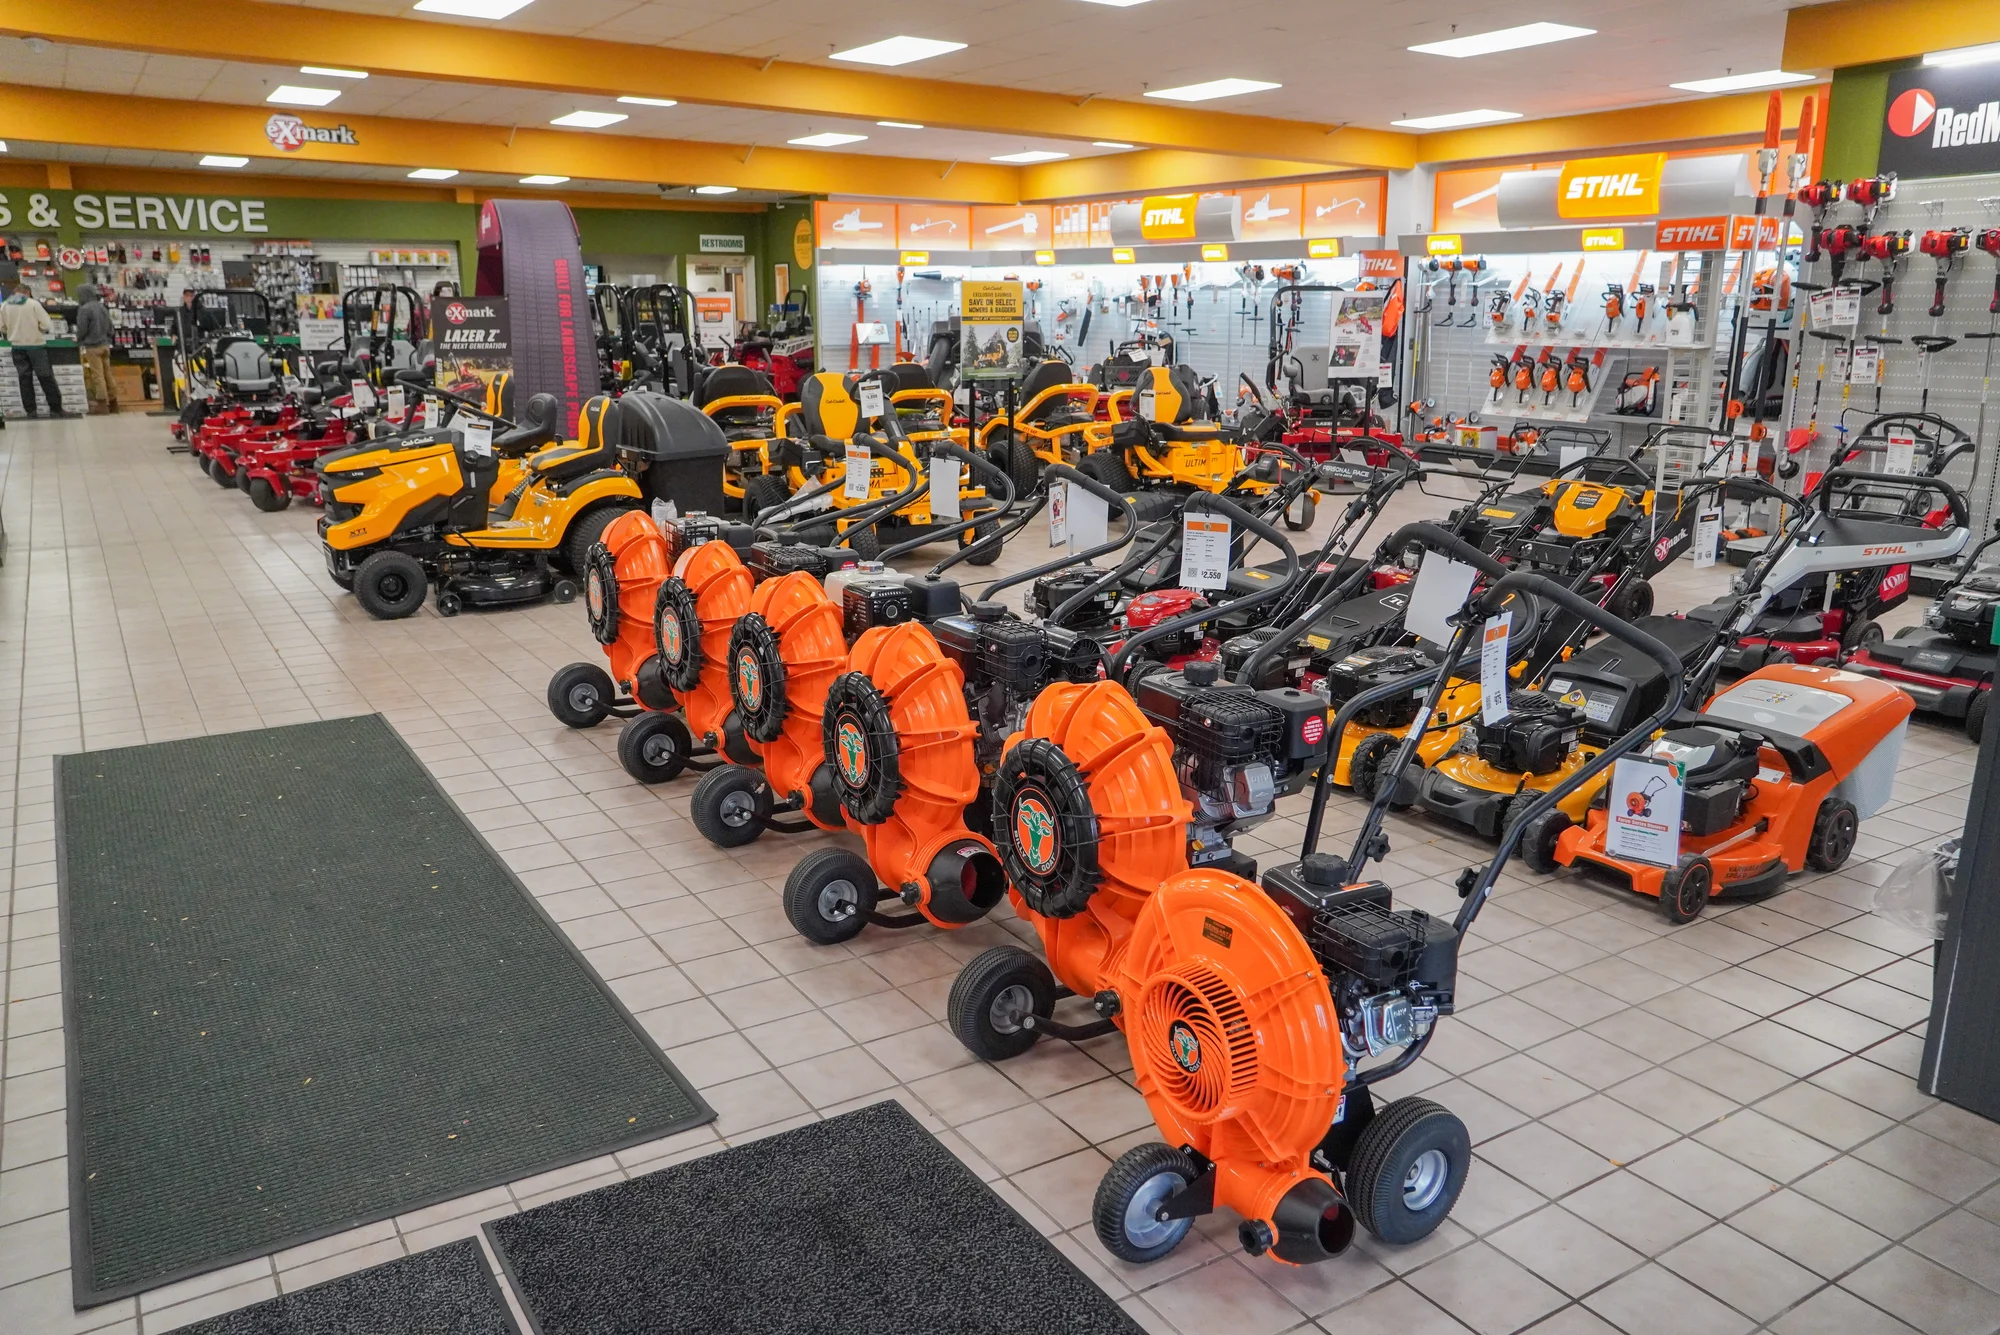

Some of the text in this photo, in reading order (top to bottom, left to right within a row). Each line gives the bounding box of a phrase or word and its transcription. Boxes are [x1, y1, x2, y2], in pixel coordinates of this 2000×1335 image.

[266, 120, 357, 144] eXmark
[1565, 173, 1644, 199] STIHL
[28, 193, 61, 227] &
[73, 195, 268, 232] SERVICE
[1144, 208, 1185, 226] STIHL
[1660, 225, 1719, 243] STIHL
[1736, 225, 1776, 242] STHL
[702, 239, 744, 248] RESTROOMS
[1431, 241, 1456, 250] STIHL
[1586, 236, 1617, 246] STIHL
[1361, 258, 1397, 271] STIHL
[995, 298, 1016, 306] SELECT
[445, 306, 495, 320] eXmark
[445, 330, 485, 342] LAZER
[555, 259, 579, 438] BUILT FOR LANDSCAPE PROS
[401, 436, 434, 447] Cub Cadet
[1185, 459, 1207, 467] ULTIM
[1322, 465, 1370, 477] PERSONAL PACE
[1655, 527, 1688, 560] eXmark
[1862, 546, 1906, 556] STIHL
[1201, 571, 1221, 579] $2,550
[1647, 822, 1667, 831] Blowers
[1014, 830, 1056, 871] BILLY GOAT
[1728, 864, 1760, 872] VARIABLE
